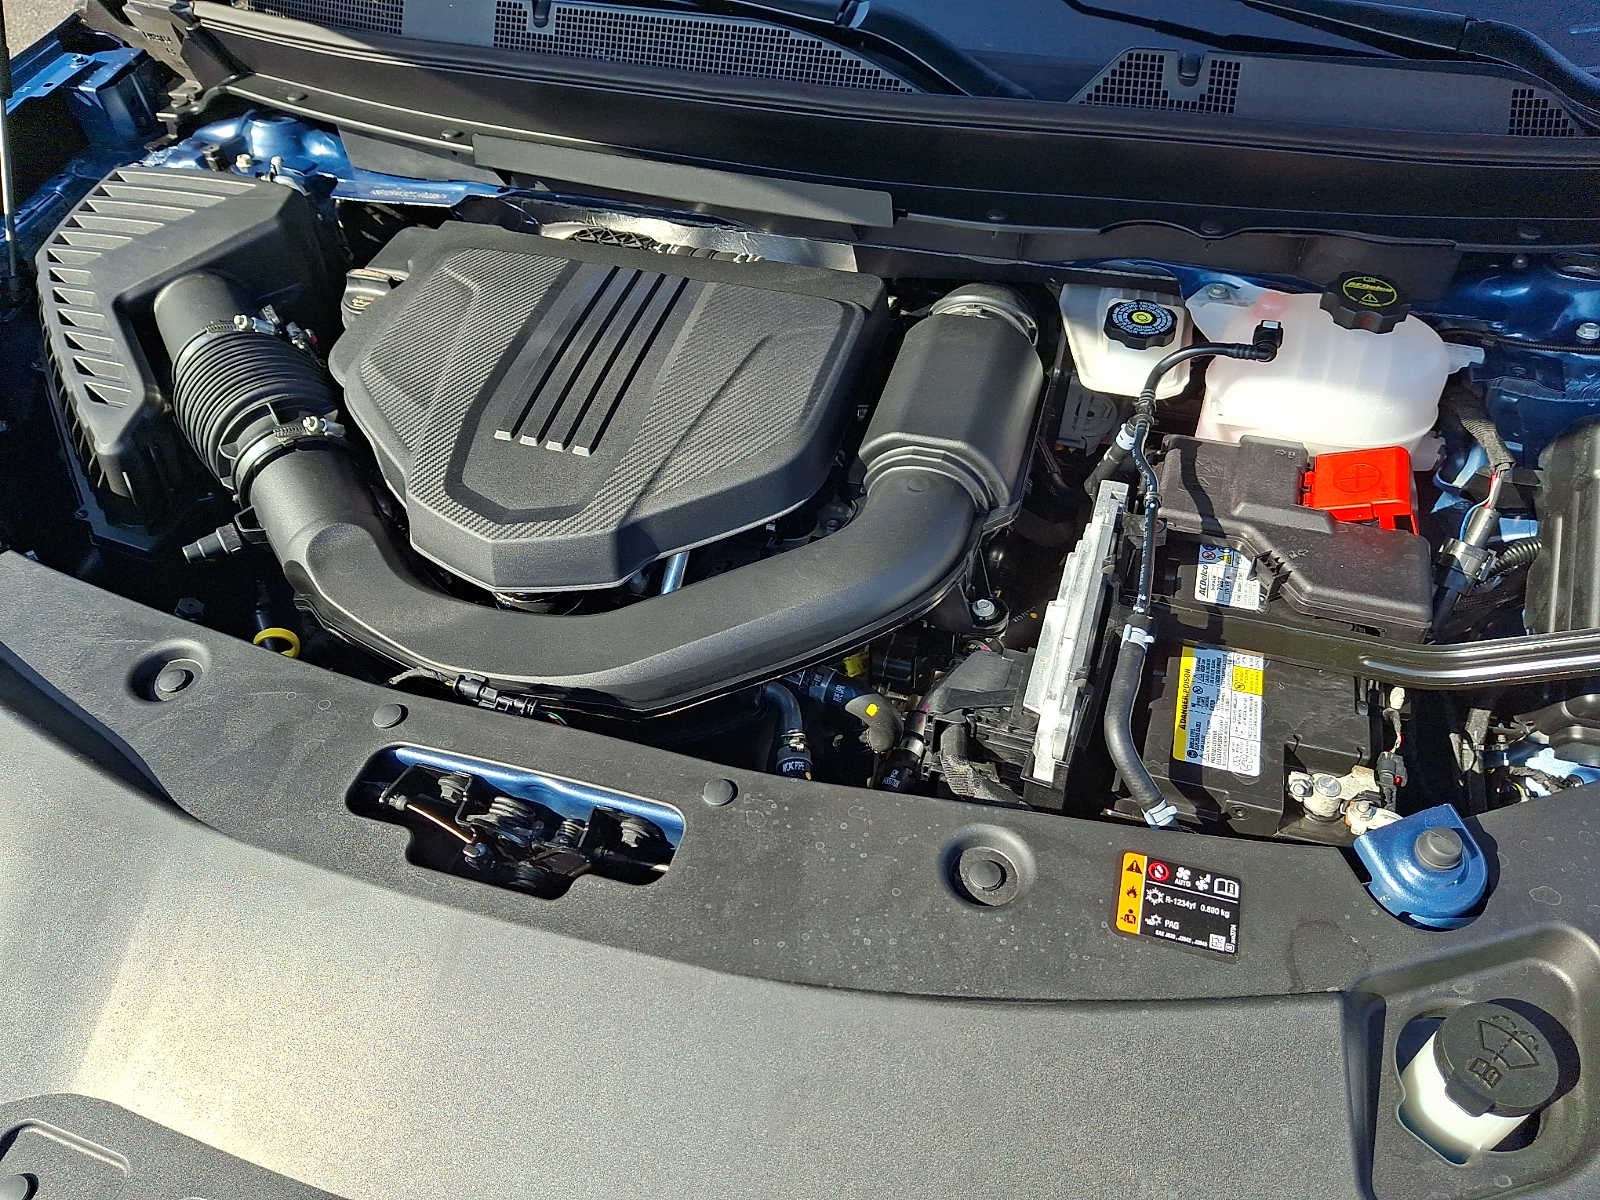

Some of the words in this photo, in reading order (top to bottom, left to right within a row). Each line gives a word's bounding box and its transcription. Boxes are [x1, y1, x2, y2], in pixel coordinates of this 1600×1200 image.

[1199, 564, 1209, 597] ACDelco
[1174, 878, 1191, 888] AUTO
[1165, 895, 1197, 910] R-1234yf
[1220, 908, 1230, 919] kg
[1165, 919, 1180, 930] PAG
